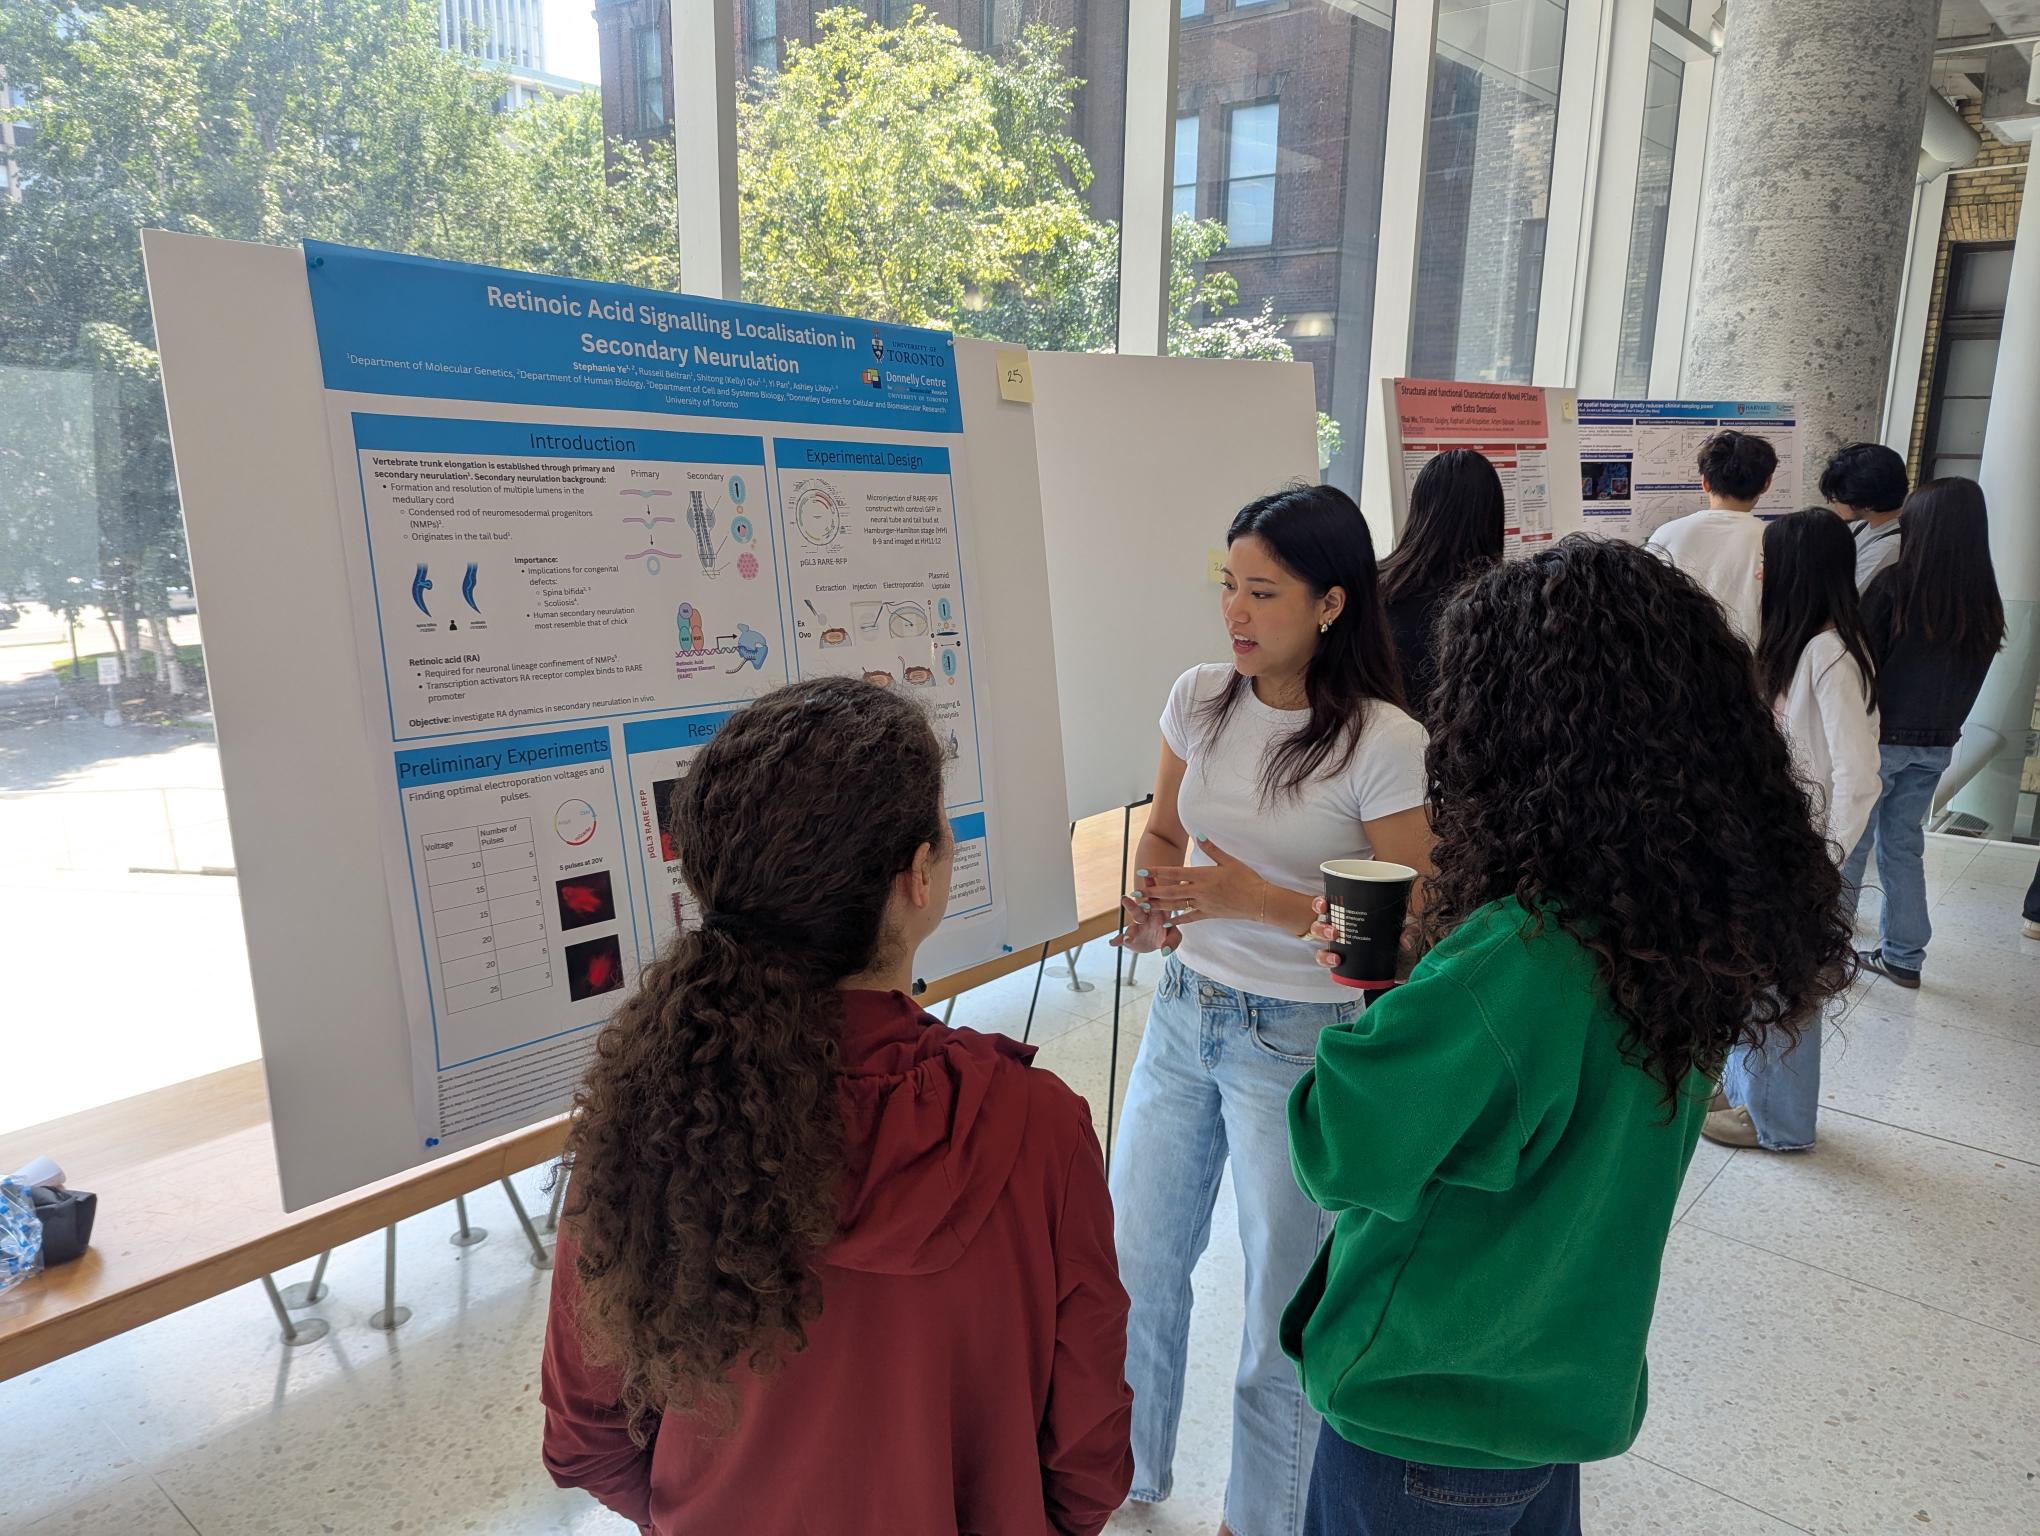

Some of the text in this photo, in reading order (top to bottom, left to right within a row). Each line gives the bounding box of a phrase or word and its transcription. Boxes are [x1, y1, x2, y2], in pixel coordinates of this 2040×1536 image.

[487, 285, 856, 350] Retinoic Acid Signalling Localisation in
[581, 333, 799, 374] Secondary Neurulation
[886, 349, 944, 368] TORONTO
[572, 361, 616, 373] Stephanie
[424, 361, 472, 374] Molecular
[474, 366, 516, 380] Genetics,
[583, 375, 614, 385] Human
[614, 377, 646, 390] Biology,
[885, 370, 946, 388] Donnelly Centre
[1008, 368, 1024, 384] 25
[1401, 386, 1427, 396] Structural
[1428, 388, 1438, 396] and
[1438, 388, 1463, 398] functional
[1464, 390, 1500, 400] Characterization
[665, 395, 739, 408] University of Toronto
[1451, 404, 1496, 414] with Extra Domains
[530, 433, 636, 452] Introduction
[806, 448, 923, 470] Experimental Design
[372, 457, 418, 467] Vertebrate
[419, 459, 443, 468] trunk
[443, 460, 487, 470] elongation
[496, 462, 540, 470] established
[540, 463, 571, 473] through
[572, 464, 600, 474] primary
[374, 470, 606, 484] secondary Secondary neurulation background:
[630, 469, 660, 480] Primary
[686, 471, 724, 482] Secondary
[390, 482, 434, 492] Formation
[434, 484, 450, 492] and
[452, 484, 492, 493] resolution
[503, 485, 534, 495] multiple
[535, 486, 563, 494] lumens
[392, 495, 455, 506] medullary cord
[408, 508, 593, 519] Condensed rod neuromesodermal progenitors
[411, 532, 492, 542] Originates the tail
[514, 557, 558, 565] Importance:
[799, 557, 848, 567] pGL3 RARE-RFP
[527, 565, 619, 576] Implications congenital
[928, 571, 949, 579] Plasmid
[529, 577, 558, 586] defects:
[852, 582, 877, 592] Injection
[882, 580, 924, 590] Electroporation
[542, 588, 563, 598] Spina
[815, 583, 847, 592] Extraction
[559, 609, 596, 618] secondary
[596, 607, 635, 615] neurulation
[553, 620, 586, 628] resemble
[408, 653, 480, 666] Retinoic acid (RA)
[424, 658, 585, 679] Required for neuronal lineage confinement
[426, 663, 643, 689] Transcription activators RA receptor complex binds RARE
[427, 692, 465, 704] promoter
[408, 716, 451, 728] Objective:
[452, 712, 495, 722] investigate
[496, 709, 507, 718] RA
[508, 706, 544, 718] dynamics
[553, 702, 591, 712] secondary
[592, 697, 632, 708] neurulation
[399, 738, 608, 779] Preliminary Experiments
[408, 765, 605, 802] Finding optimal electroporation voltages and
[500, 791, 531, 804] pulses.
[479, 823, 517, 837] Number of
[640, 790, 658, 859] pGL3 RARE-RFP
[424, 841, 454, 851] Voltage
[480, 836, 504, 846] Pulses
[471, 861, 481, 869] 10
[564, 861, 584, 871] pulses
[476, 885, 485, 894] 15
[479, 910, 488, 919] 15
[481, 935, 492, 944] 20
[486, 960, 496, 969] 20
